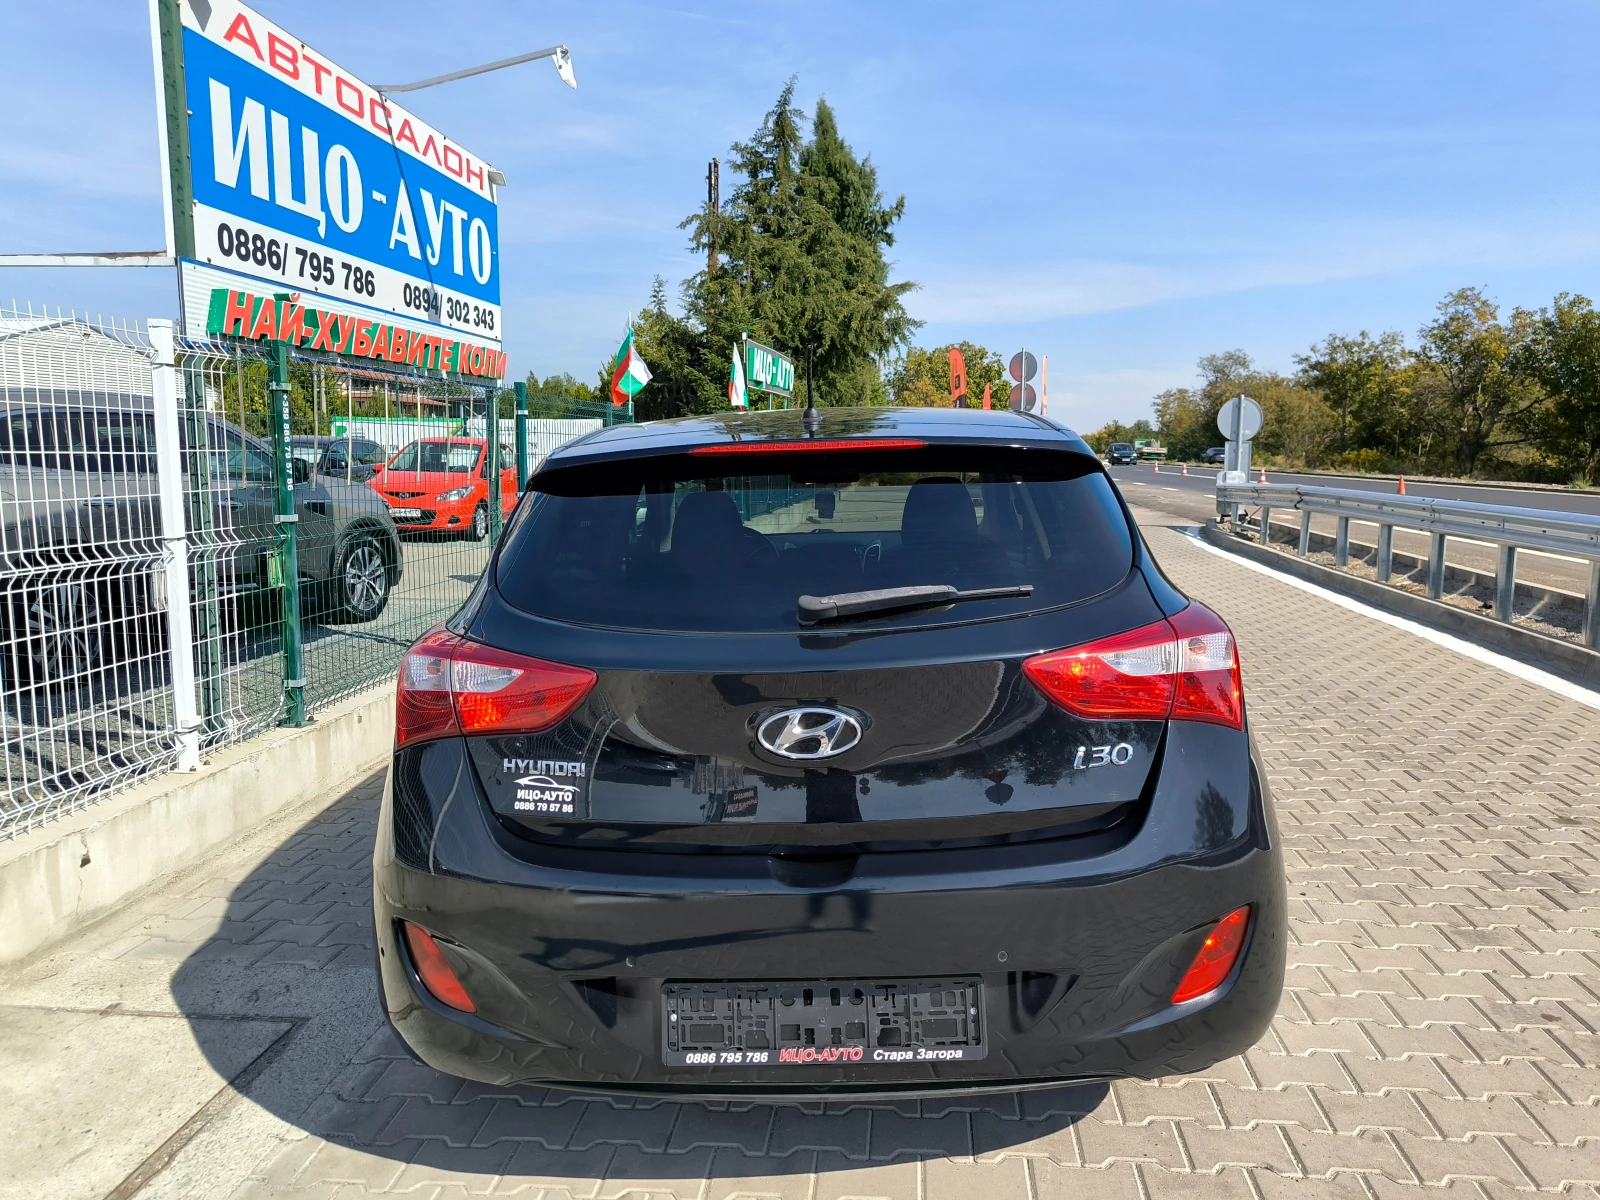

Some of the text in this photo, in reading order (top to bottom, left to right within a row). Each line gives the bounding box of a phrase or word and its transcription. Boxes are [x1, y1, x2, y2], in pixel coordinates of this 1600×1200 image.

[223, 12, 484, 192] АВТОСАЛОН
[217, 223, 376, 298] 0886/ 795 786
[403, 282, 495, 331] 0894/ 302 343
[223, 289, 507, 380] НАЙ-ХУБАВИТЕ КОЛИ
[503, 758, 585, 777] HYUNDAI
[1073, 742, 1133, 769] i30
[514, 801, 573, 813] 0886 79 57 86
[516, 789, 573, 802] ИЦО-АУТО
[686, 1047, 963, 1064] 0886 795 786 ИЦО-АУТО Стара Загора
